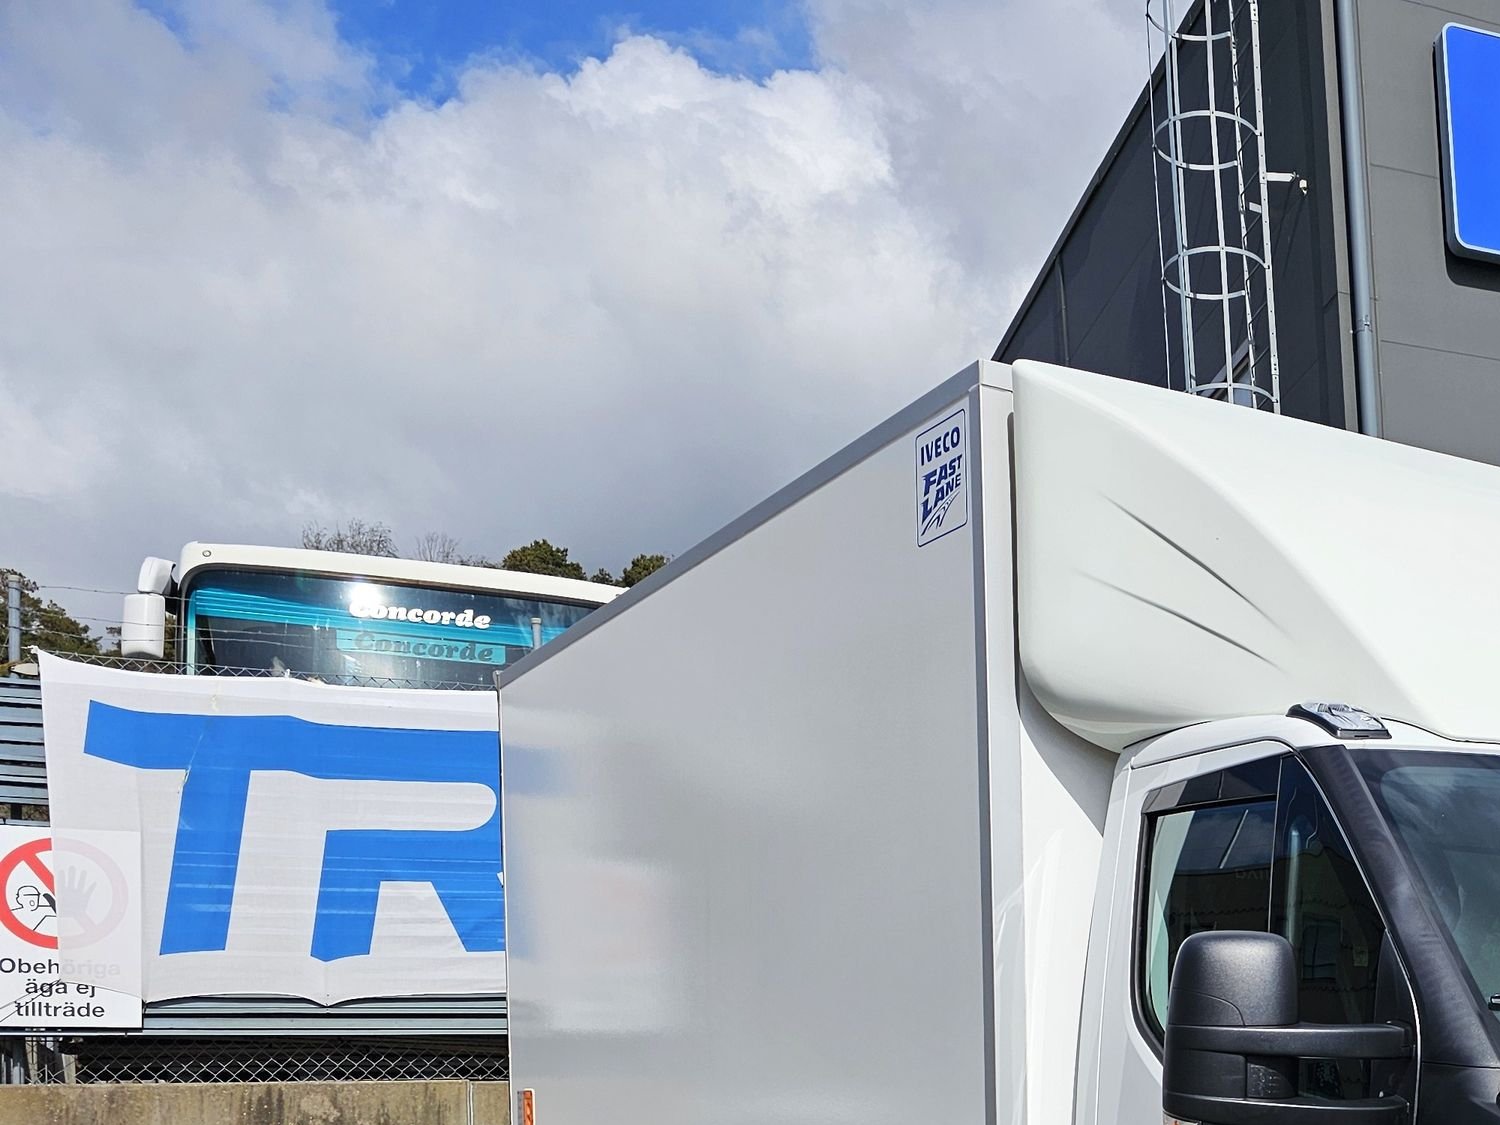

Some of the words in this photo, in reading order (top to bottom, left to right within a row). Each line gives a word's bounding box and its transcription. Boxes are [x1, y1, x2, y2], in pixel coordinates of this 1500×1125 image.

[920, 426, 961, 466] IVECO
[922, 454, 963, 498] FAST
[920, 473, 962, 525] LANE
[349, 601, 492, 630] Concorde
[354, 632, 494, 663] Concorde
[25, 978, 68, 997] äga
[15, 1001, 105, 1017] tillträde
